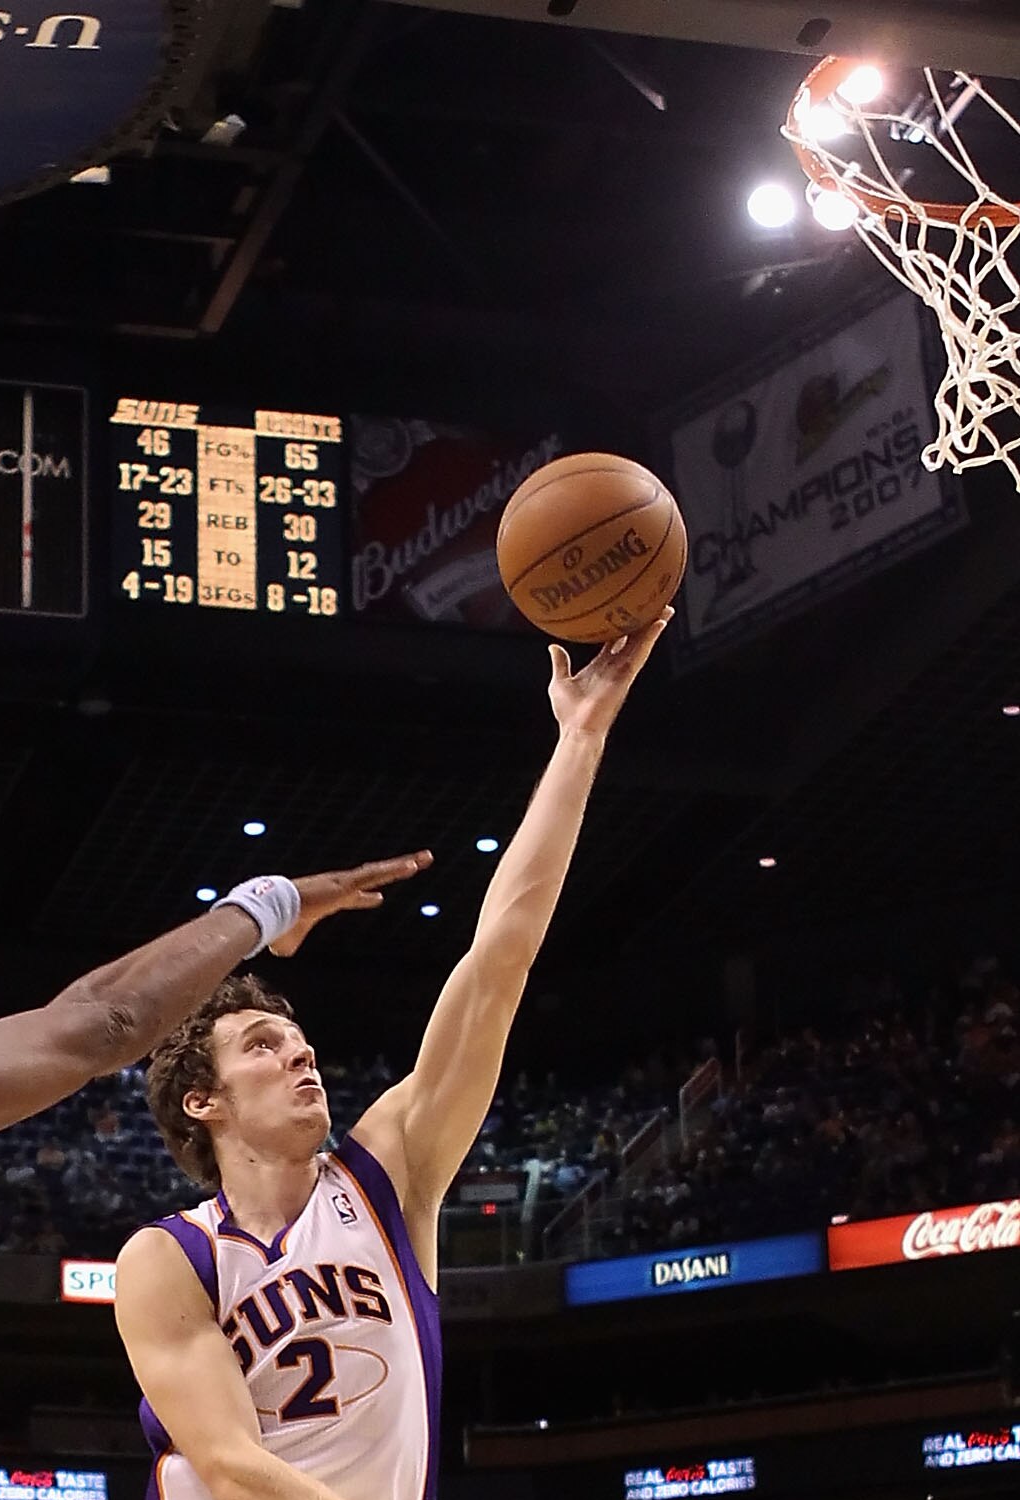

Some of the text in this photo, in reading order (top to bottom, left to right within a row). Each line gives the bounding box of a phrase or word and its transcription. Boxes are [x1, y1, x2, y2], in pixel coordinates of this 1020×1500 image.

[113, 398, 201, 428] SUNS
[136, 428, 319, 471] 46 FG% 65
[118, 462, 195, 496] 17-23
[259, 475, 337, 508] 26-33
[691, 423, 923, 577] CHAMPIONS
[138, 500, 318, 543] 29 REB 30
[140, 538, 319, 580] 15 TO 12
[530, 527, 649, 612] SPALDING
[654, 1254, 728, 1286] DASANI
[274, 1335, 342, 1424] 2
[923, 1432, 967, 1452] REAL
[924, 1451, 955, 1468] AND
[955, 1447, 993, 1467] ZERO
[54, 1470, 108, 1489] TASTE
[625, 1467, 665, 1487] REAL
[706, 1456, 755, 1479] TASTE
[654, 1481, 690, 1500] ZERO
[690, 1474, 756, 1496] CALORIES
